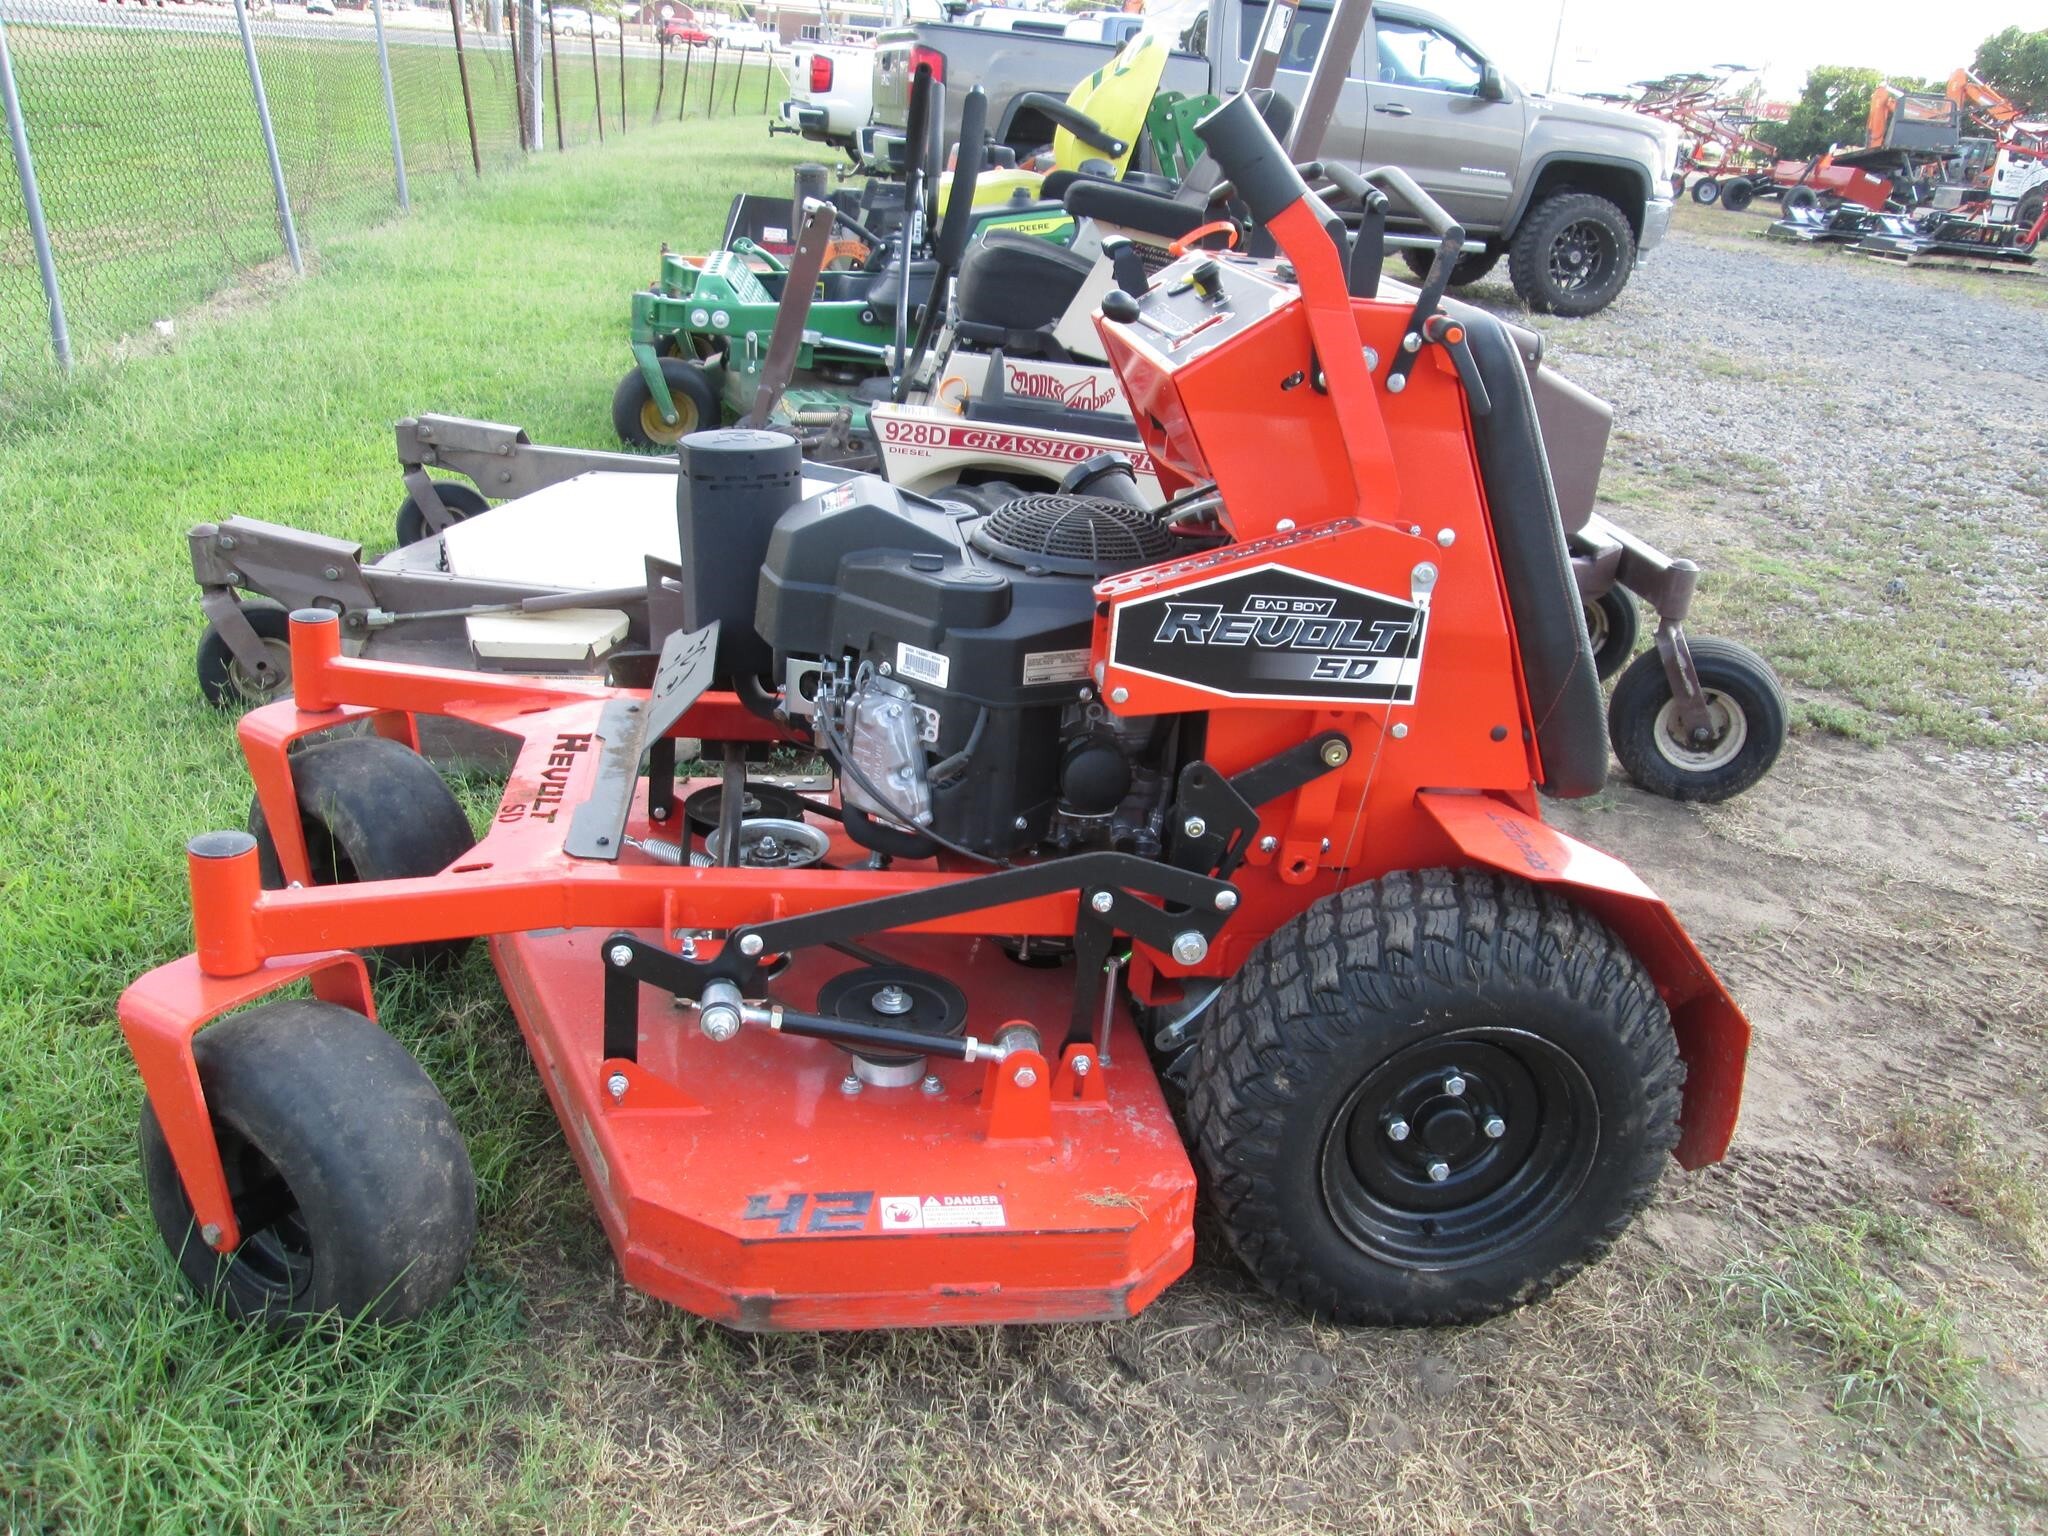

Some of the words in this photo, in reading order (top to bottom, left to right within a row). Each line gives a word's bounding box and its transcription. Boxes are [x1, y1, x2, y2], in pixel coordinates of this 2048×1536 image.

[1460, 167, 1506, 178] SIERRA
[1019, 223, 1050, 232] DEERE
[885, 421, 946, 445] 928D
[889, 446, 932, 457] DIESEL
[1255, 600, 1289, 611] BAD
[1293, 601, 1327, 612] BOY
[1154, 602, 1413, 652] REVOLT
[1311, 655, 1379, 680] SD
[529, 732, 593, 824] REVOLT
[943, 1195, 999, 1206] DANGER
[743, 1191, 875, 1234] 42
